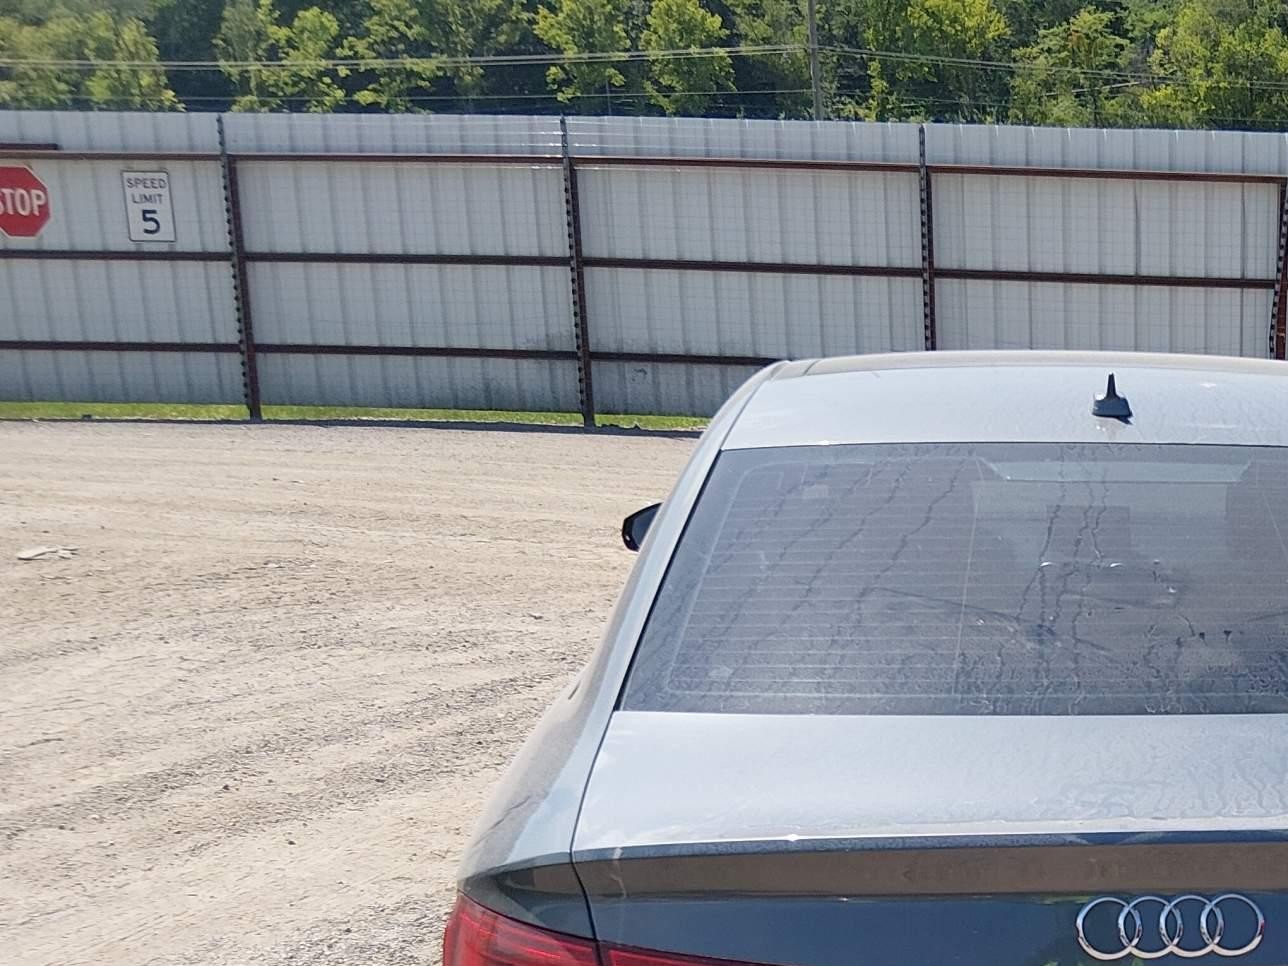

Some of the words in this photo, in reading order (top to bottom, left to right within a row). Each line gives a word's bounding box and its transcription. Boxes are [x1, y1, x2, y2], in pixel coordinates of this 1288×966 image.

[127, 177, 167, 189] SPEED
[132, 193, 162, 204] LIMIT
[142, 209, 160, 234] 5
